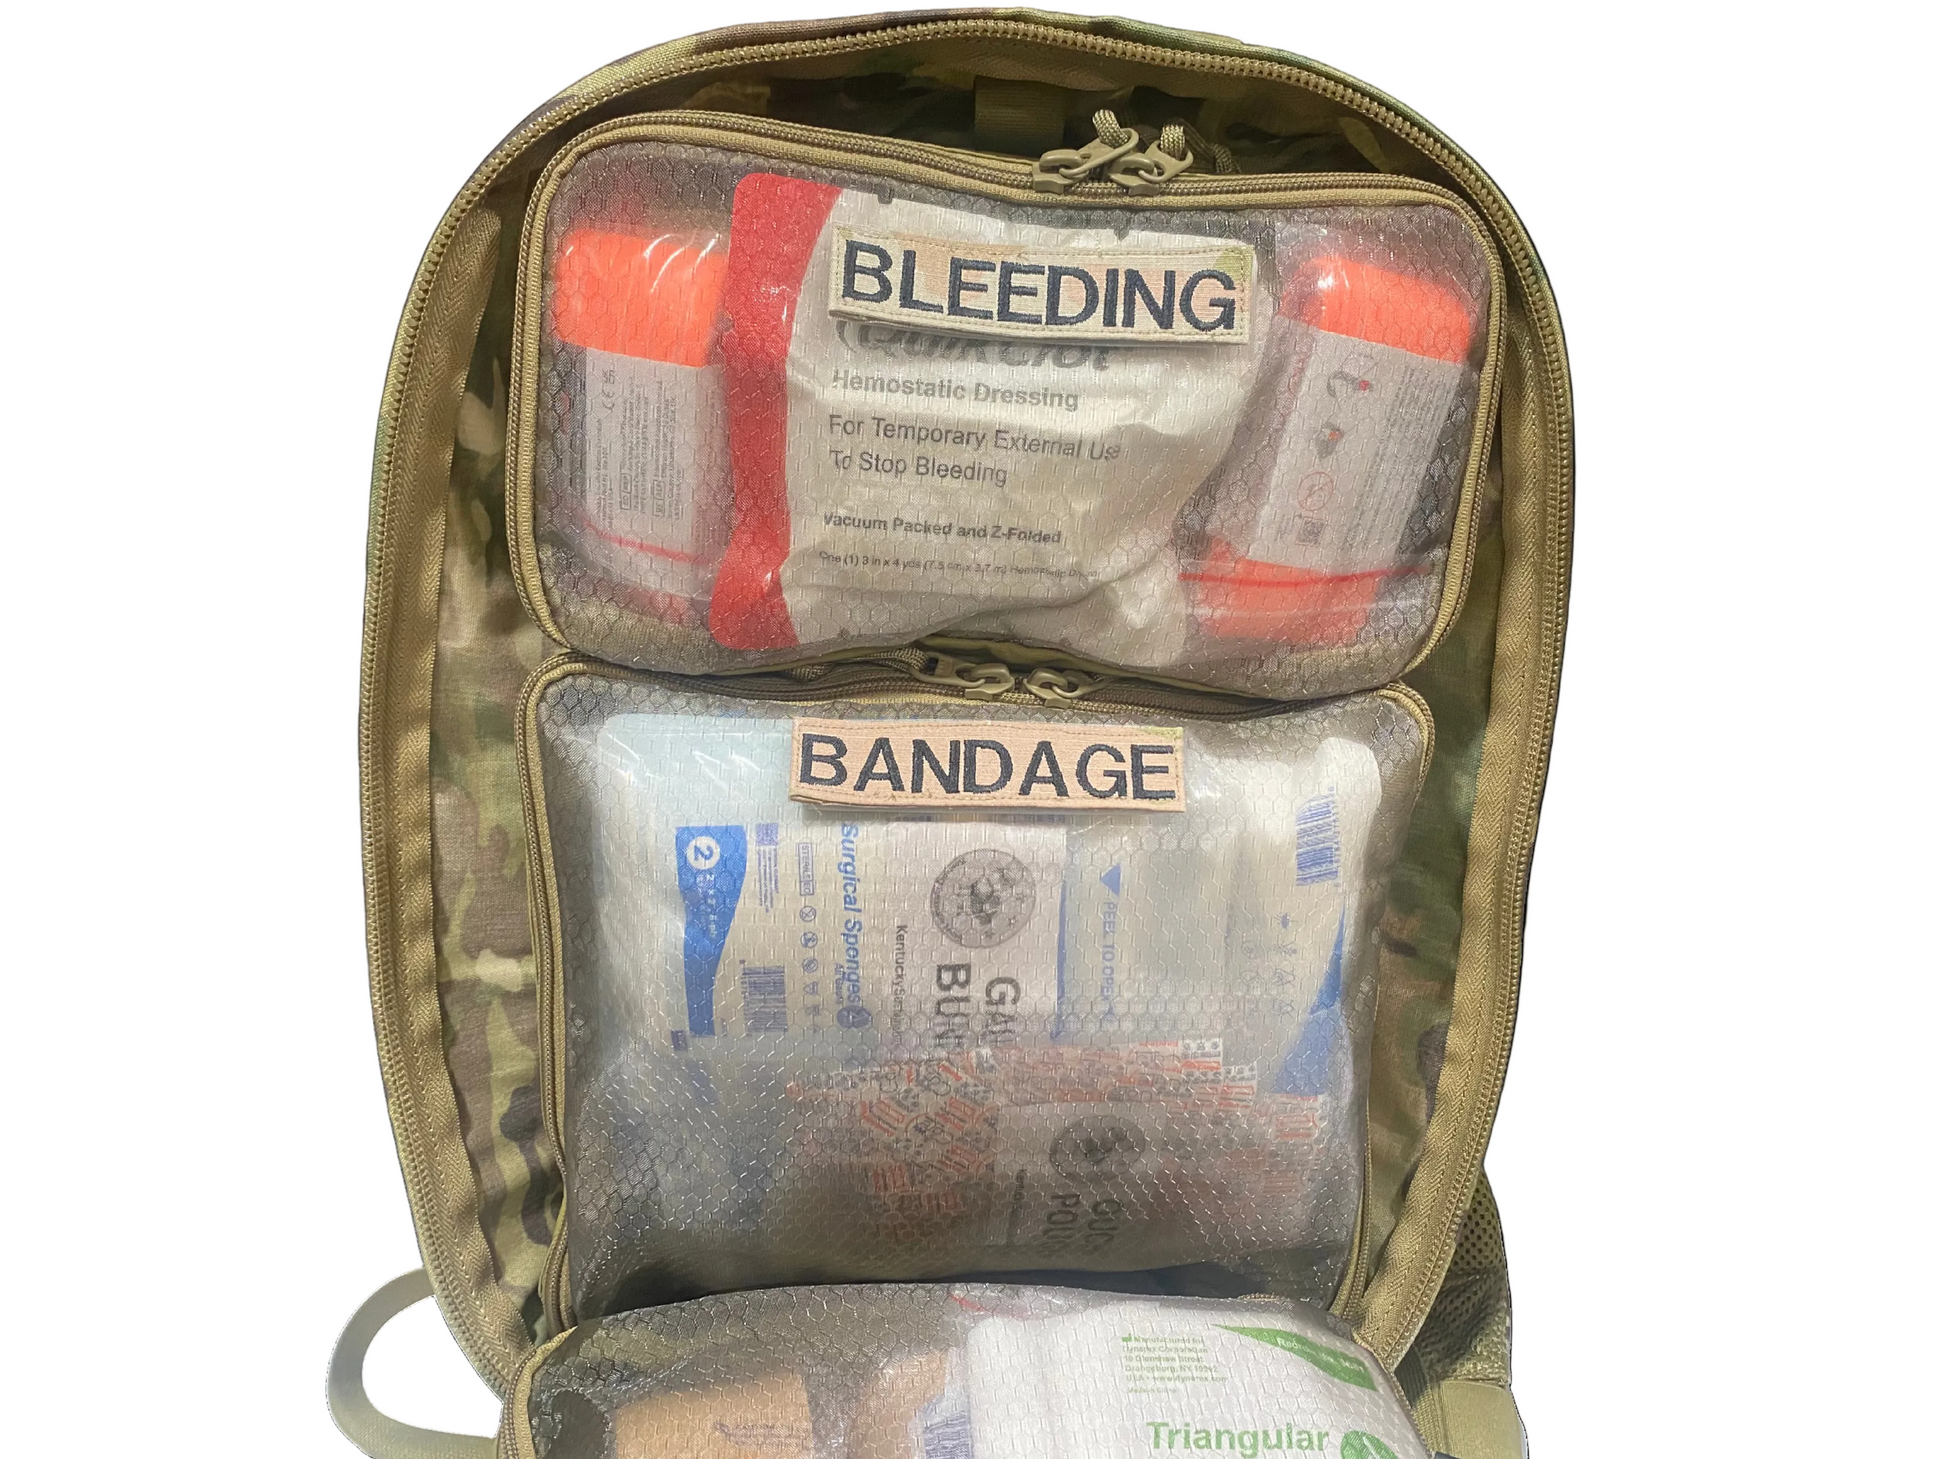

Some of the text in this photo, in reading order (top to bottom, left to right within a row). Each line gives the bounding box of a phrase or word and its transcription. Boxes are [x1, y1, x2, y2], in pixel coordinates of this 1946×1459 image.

[841, 239, 1236, 332] BLEEDING
[832, 368, 1079, 411] Hemostatic Dressing
[829, 414, 1121, 461] For Temporary External Use
[830, 450, 1008, 488] To Stop Bleeding
[823, 511, 1062, 543] Vacuum Packed and Z-Folded
[819, 550, 841, 563] One
[862, 555, 869, 566] 3
[871, 555, 881, 566] in
[799, 733, 1176, 800] BANDAGE
[694, 845, 714, 861] 2
[838, 823, 863, 1008] Surgical Sponges
[1103, 902, 1116, 939] PEEL
[1102, 944, 1115, 961] TO
[1146, 1422, 1329, 1459] Triangular
